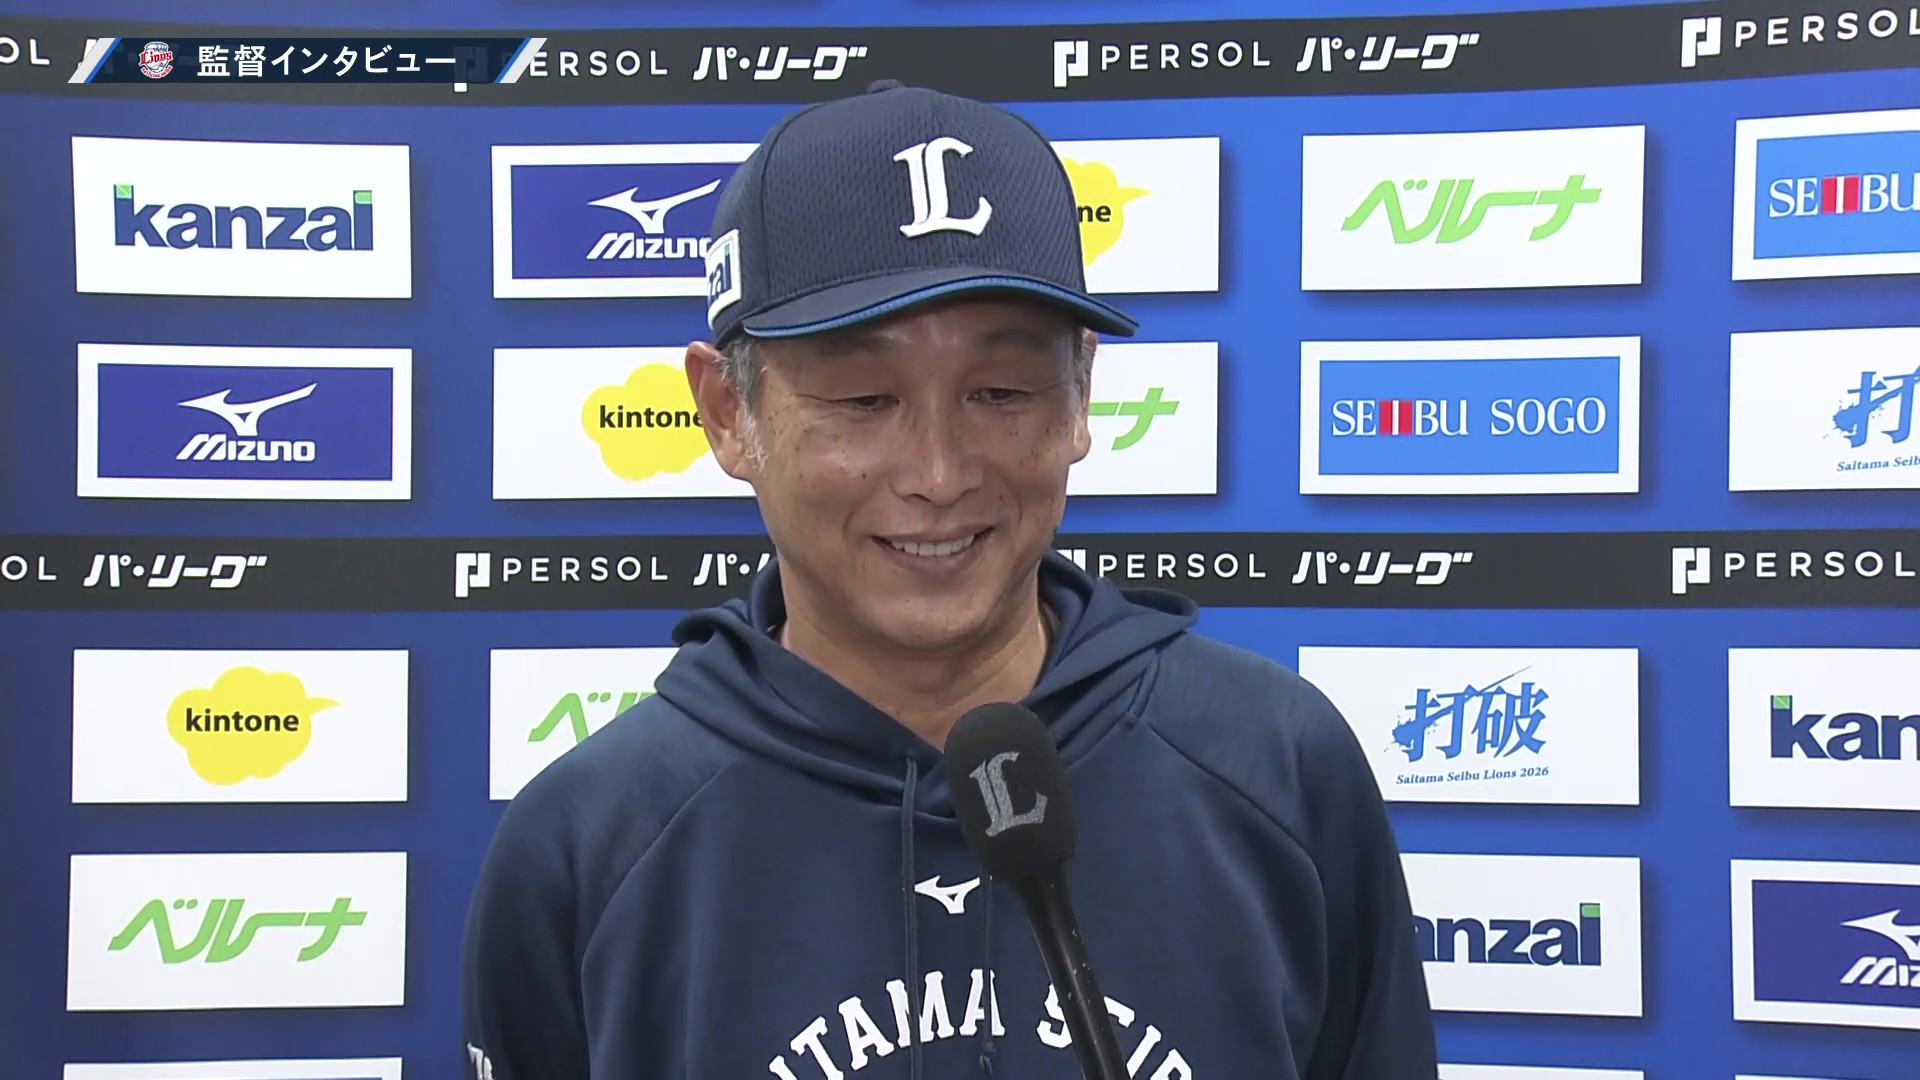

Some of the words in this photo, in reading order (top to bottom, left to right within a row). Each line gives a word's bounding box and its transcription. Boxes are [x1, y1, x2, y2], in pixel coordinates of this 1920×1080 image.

[1736, 9, 1920, 49] PERSOL
[529, 46, 669, 78] ERSOL
[693, 46, 868, 81] パ・リーグ
[1101, 42, 1271, 71] PERSOL
[1296, 33, 1480, 72] パ・リーグ
[893, 137, 993, 239] L
[114, 184, 374, 252] kanzai
[1340, 174, 1603, 246] ベルーナ
[1332, 399, 1469, 436] SEIBU
[1490, 397, 1606, 436] SOGO
[1836, 460, 1889, 472] Saitama
[83, 554, 268, 589] パ・リーグ
[502, 556, 668, 582] PERSOL
[1098, 553, 1267, 579] PERSOL
[1291, 551, 1473, 586] パ・リーグ
[1724, 551, 1916, 578] PERSOL
[185, 708, 299, 733] kintone
[1391, 678, 1551, 763] 打破
[969, 751, 1048, 837] L
[1396, 773, 1444, 785] Saitama
[1446, 771, 1480, 782] Seibu
[1483, 768, 1517, 780] Lions
[1519, 766, 1549, 777] 2026
[107, 898, 368, 965] ベルーナ
